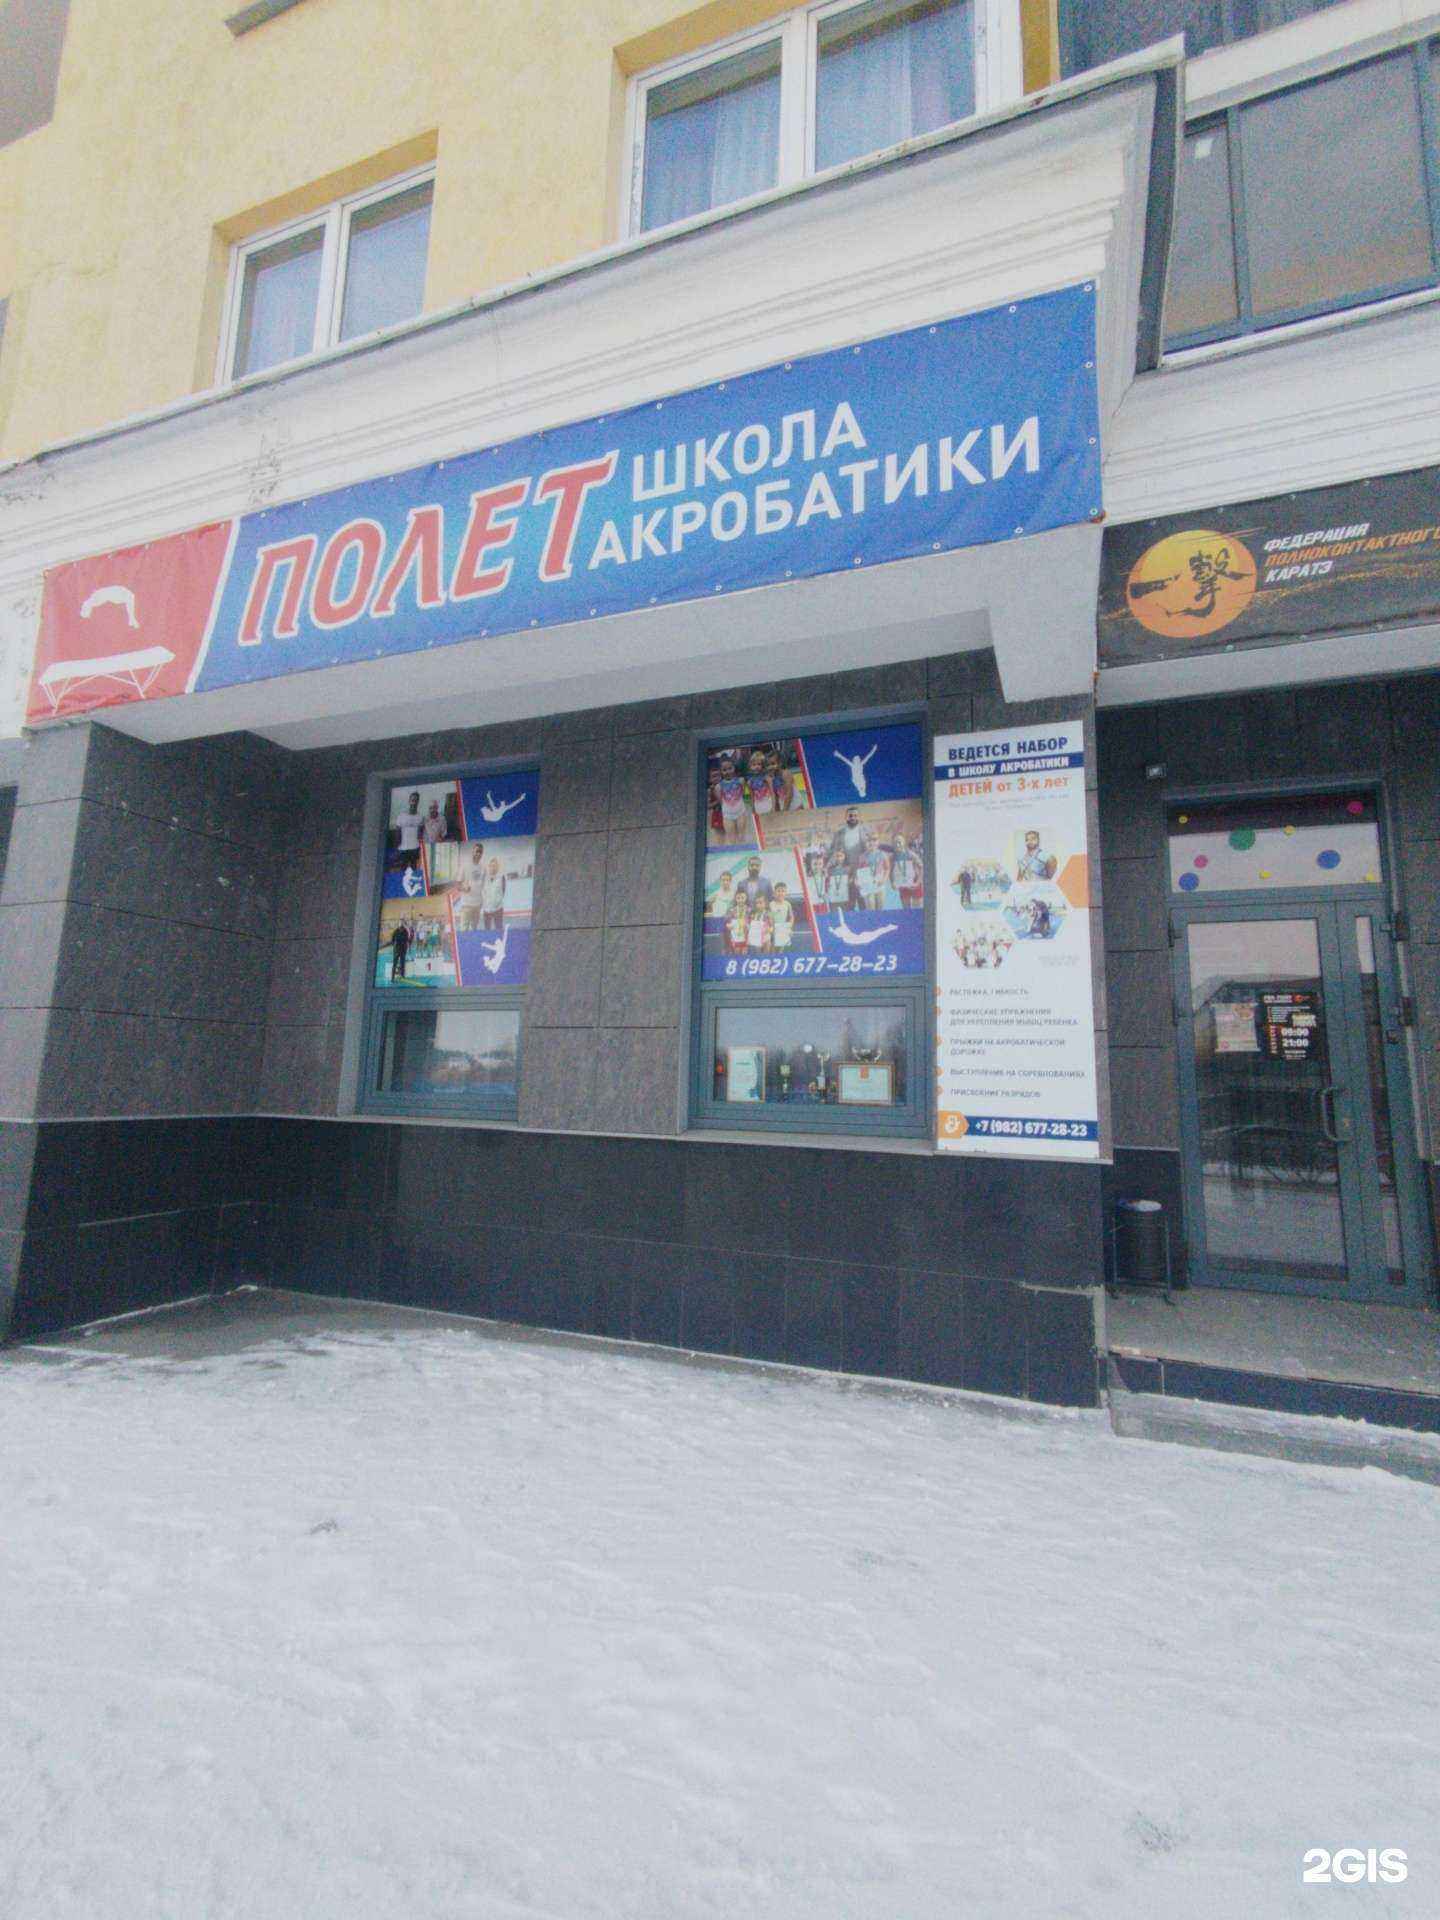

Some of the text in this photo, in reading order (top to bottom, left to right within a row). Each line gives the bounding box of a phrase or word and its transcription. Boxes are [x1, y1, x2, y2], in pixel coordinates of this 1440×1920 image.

[633, 401, 867, 502] ШКОЛА
[588, 416, 1040, 570] АКРОБАТИКИ
[238, 449, 620, 647] ПОЛЕТ
[1264, 523, 1370, 551] ФЕДЕРАЦИЯ
[1265, 560, 1334, 583] КАРАТЭ
[948, 736, 1068, 762] ВЕДЕТСЯ НАБОР
[948, 756, 1069, 777] В ШКОЛУ АКРОБАТИКИ
[949, 779, 993, 798] ДЕТЕЙ
[996, 782, 1012, 792] от
[1044, 776, 1069, 789] лет
[726, 961, 737, 975] 8
[741, 957, 788, 975] (982)
[975, 1119, 1088, 1138] +7 (982) 677-28-23
